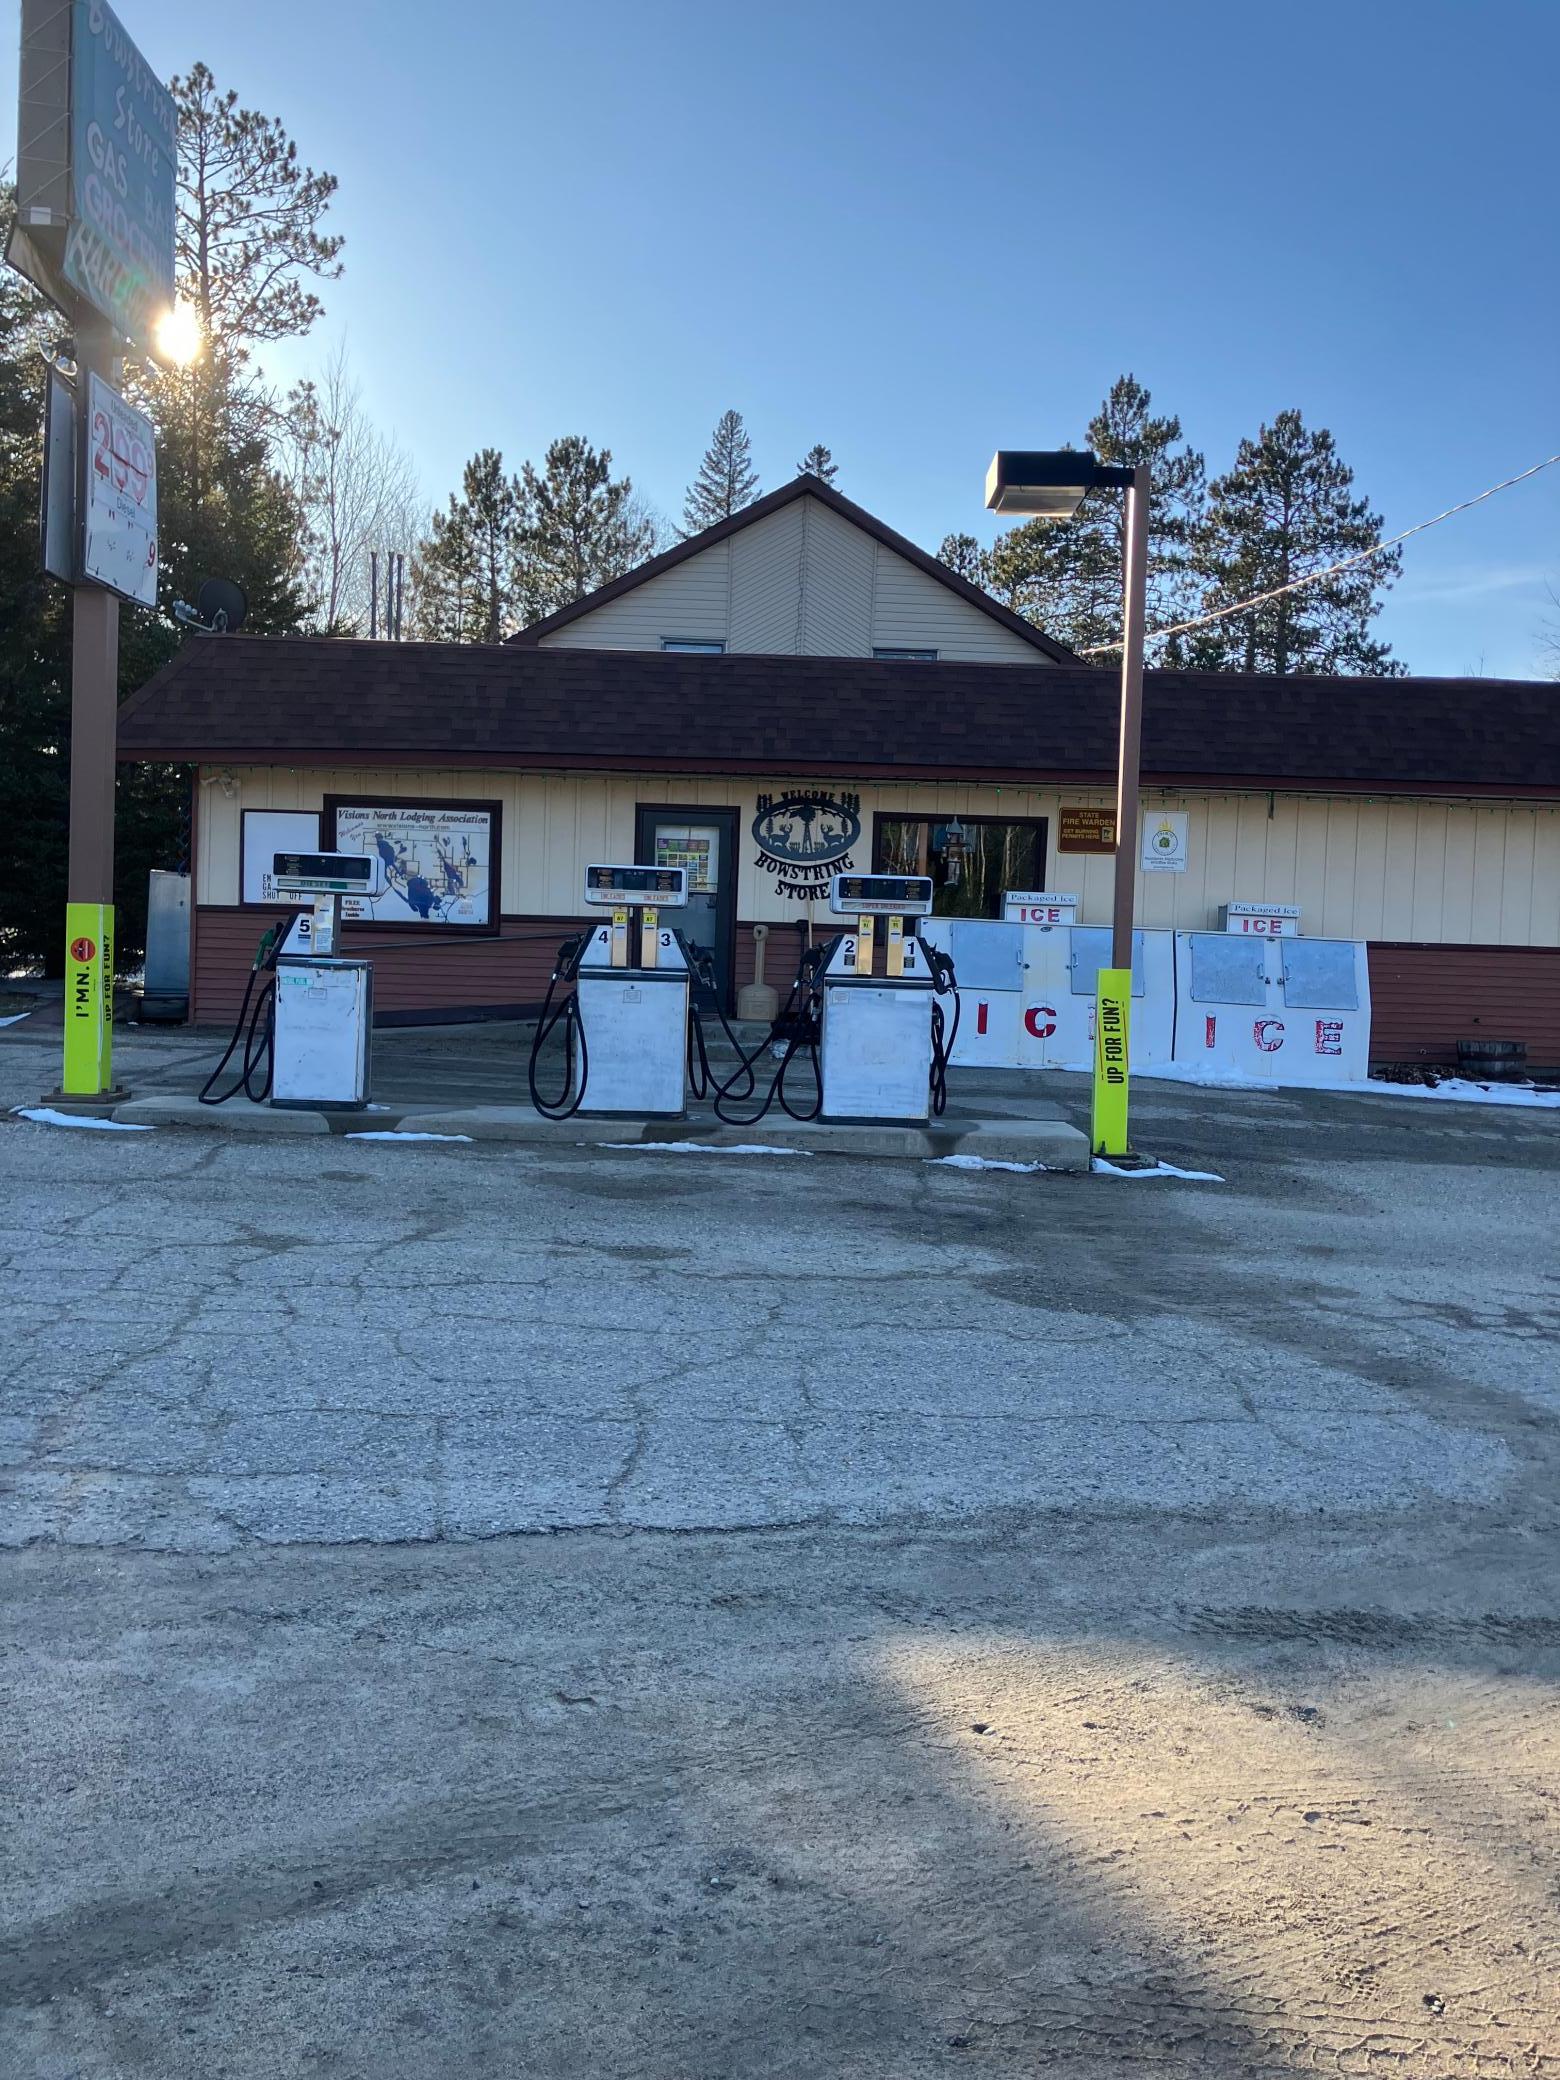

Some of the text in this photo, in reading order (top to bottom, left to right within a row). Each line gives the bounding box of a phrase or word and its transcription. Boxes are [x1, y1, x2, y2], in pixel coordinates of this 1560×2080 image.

[114, 85, 160, 177] Store
[87, 121, 128, 199] GAS
[148, 542, 155, 566] 9
[781, 789, 835, 801] WELCOME
[338, 810, 488, 825] Visions North Lodging Association
[754, 850, 854, 881] BOWSTRING
[263, 891, 280, 900] SHUT
[775, 879, 831, 900] STORE
[1011, 894, 1075, 903] Packaged Ice
[1021, 908, 1060, 922] ICE
[1234, 904, 1298, 915] Packaged Ice
[300, 919, 311, 933] 5
[1243, 919, 1283, 934] ICE
[598, 930, 609, 943] 4
[660, 933, 671, 946] 3
[845, 940, 855, 953] 2
[907, 942, 915, 954] 1
[105, 1005, 112, 1021] UP
[1102, 998, 1125, 1084] UP FOR FUN?
[1205, 1012, 1343, 1056] ICE
